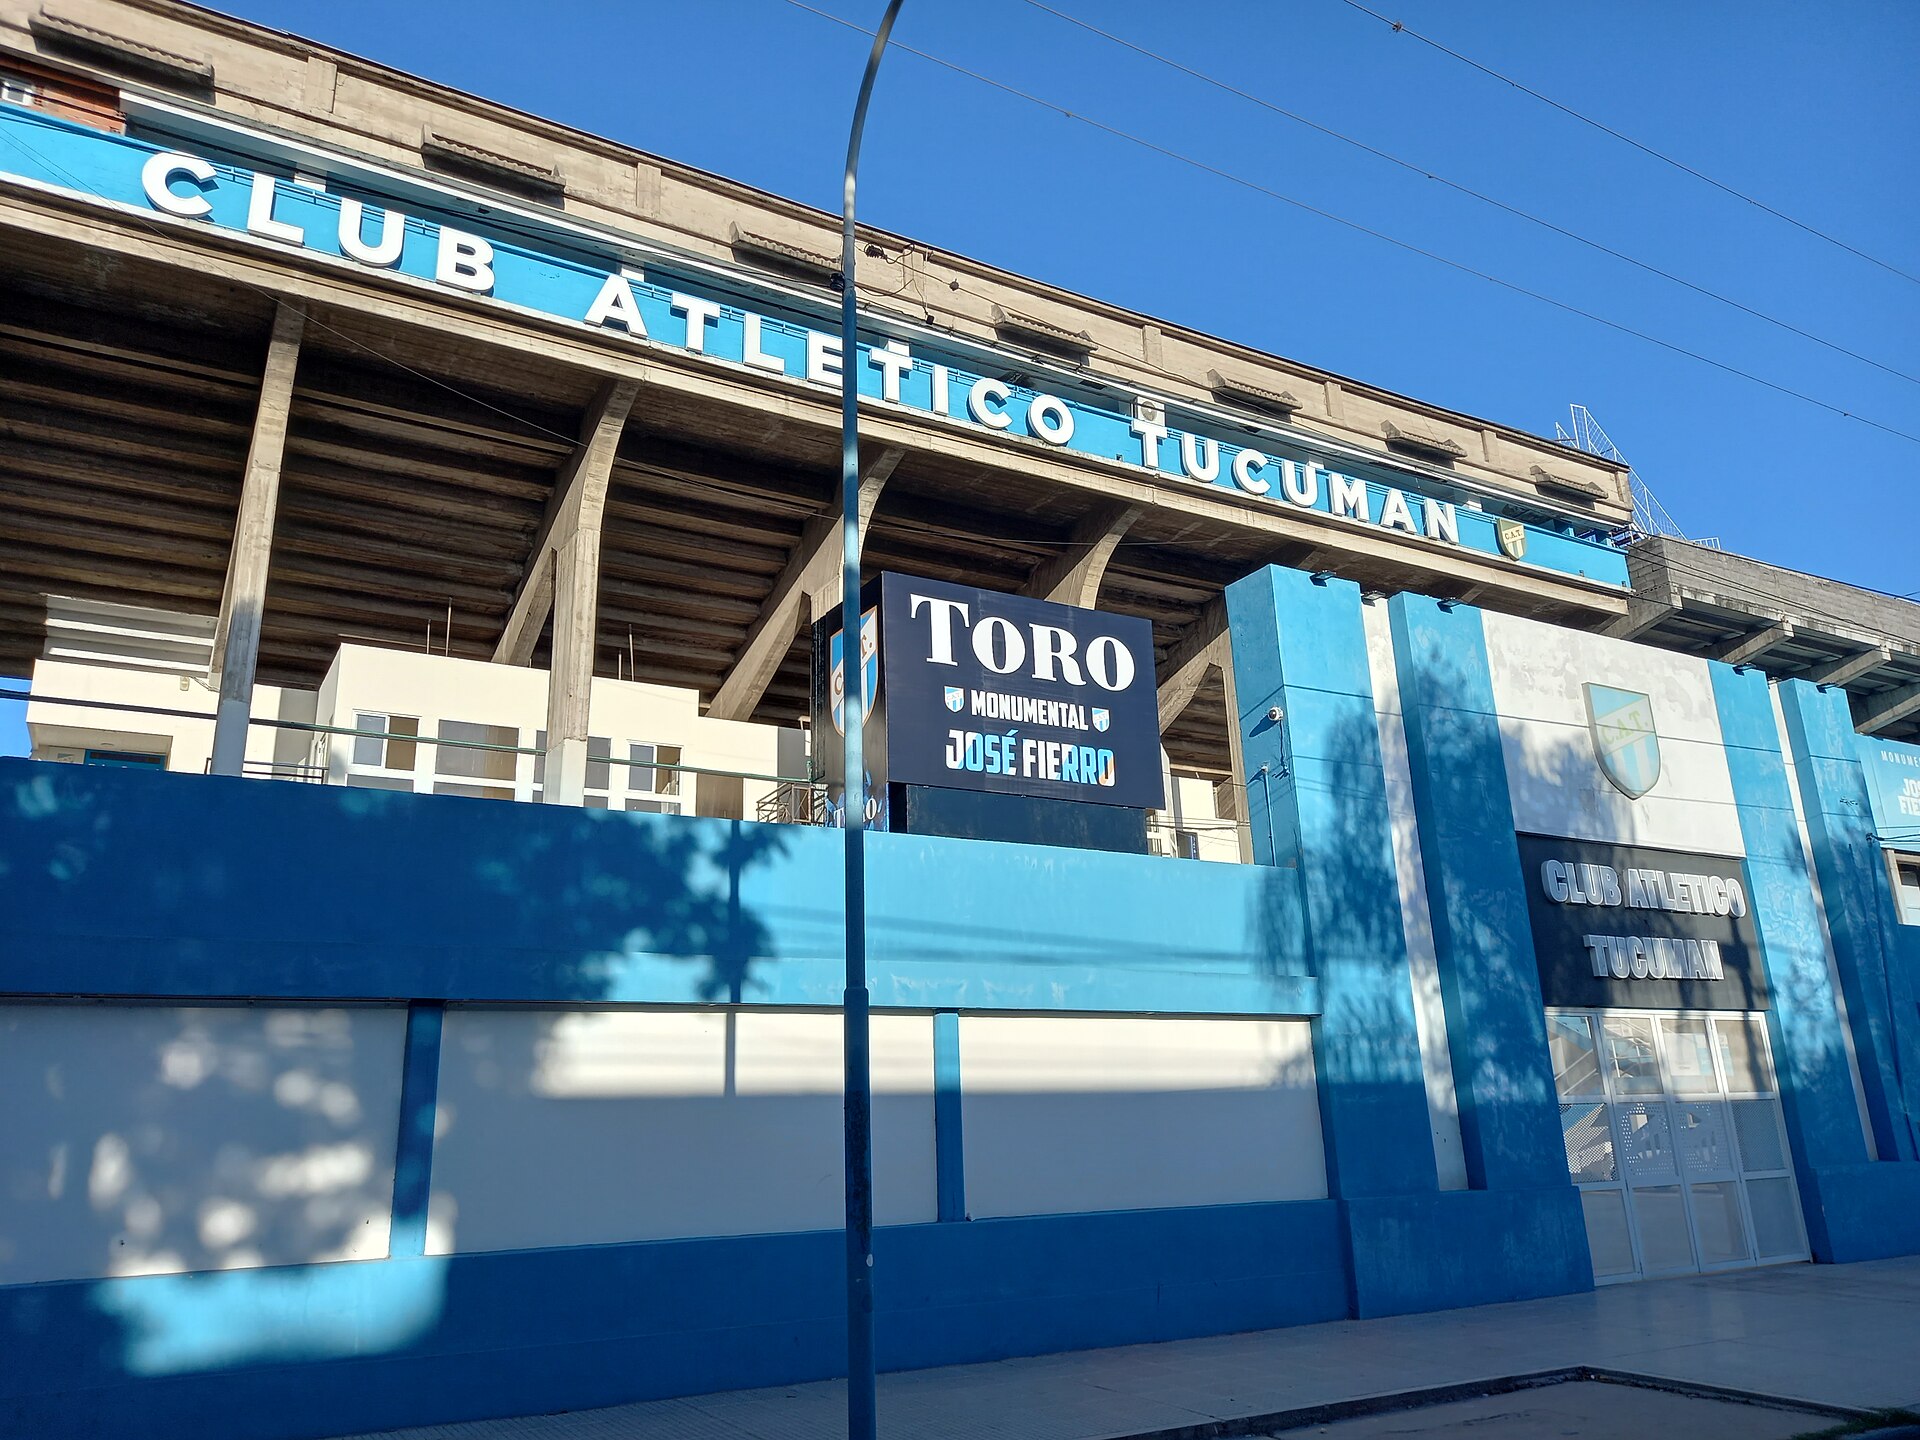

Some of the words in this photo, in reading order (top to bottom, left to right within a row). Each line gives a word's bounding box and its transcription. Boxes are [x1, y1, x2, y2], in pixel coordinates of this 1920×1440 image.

[142, 152, 496, 294] CLUB
[584, 273, 1075, 446] ATLETICO
[1132, 419, 1460, 545] TUCUMAN
[910, 593, 1136, 692] TORO
[970, 689, 1089, 731] MONUMENTAL
[945, 729, 1019, 776] JOSÉ
[1022, 738, 1116, 788] FIERRO
[1881, 750, 1920, 767] MONUME
[1541, 859, 1622, 906] CLUB
[1623, 868, 1747, 918] ATLETICO
[1583, 934, 1724, 980] TUCUMAN
